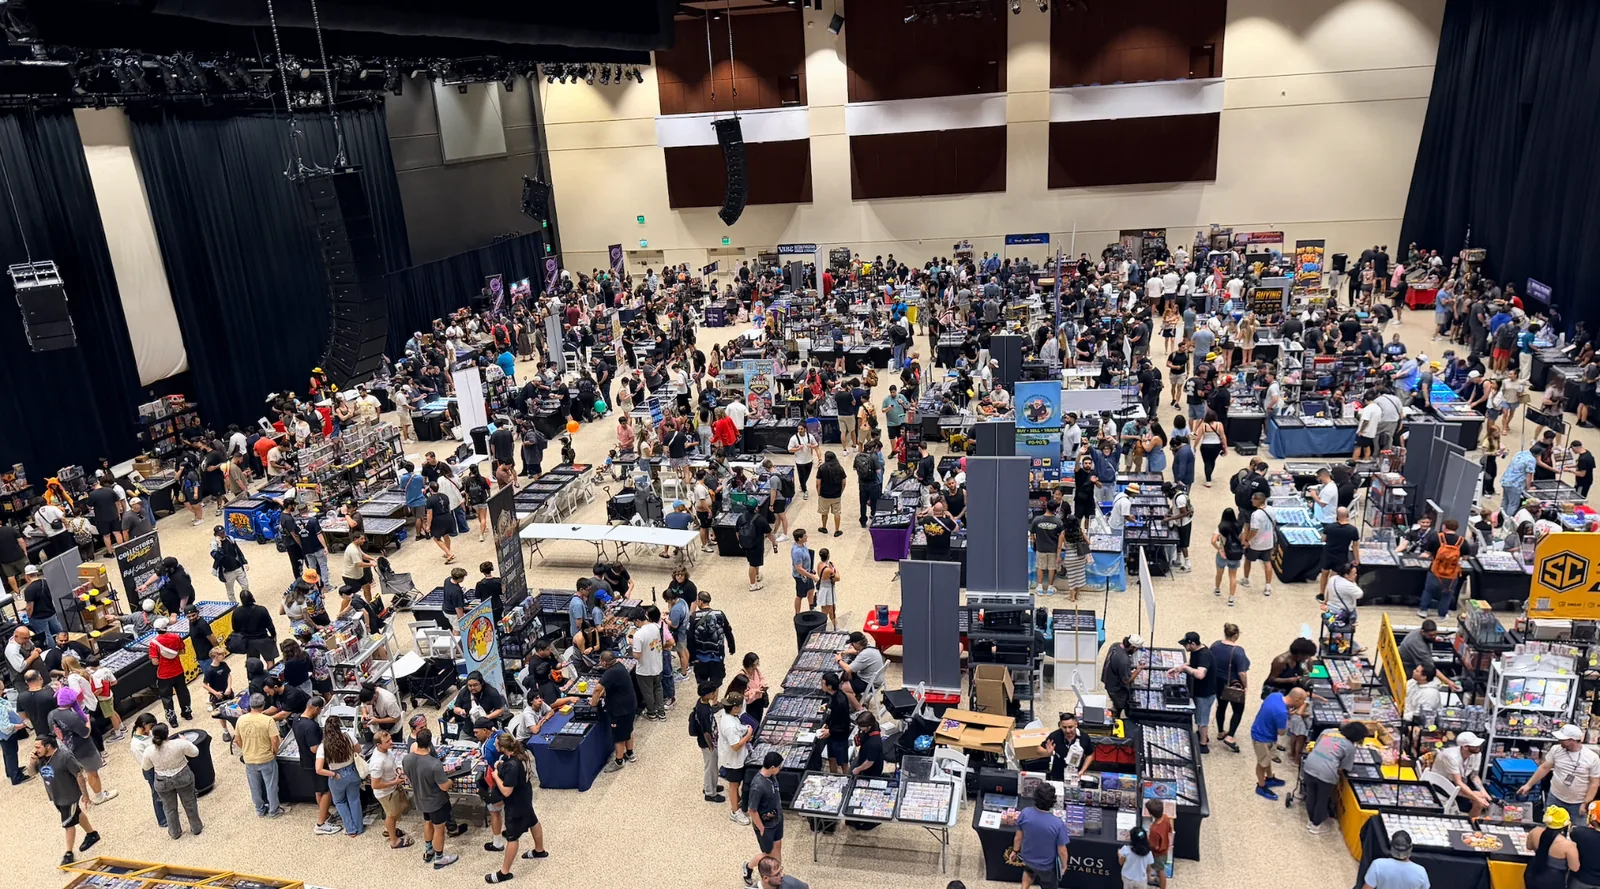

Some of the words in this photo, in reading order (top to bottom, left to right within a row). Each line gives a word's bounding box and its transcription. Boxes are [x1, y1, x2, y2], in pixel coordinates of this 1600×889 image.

[1256, 291, 1281, 299] BUYING
[118, 538, 154, 560] COLLECTORS
[1544, 555, 1584, 588] SC
[1069, 855, 1104, 868] NGS
[1066, 865, 1110, 876] CTABLES
